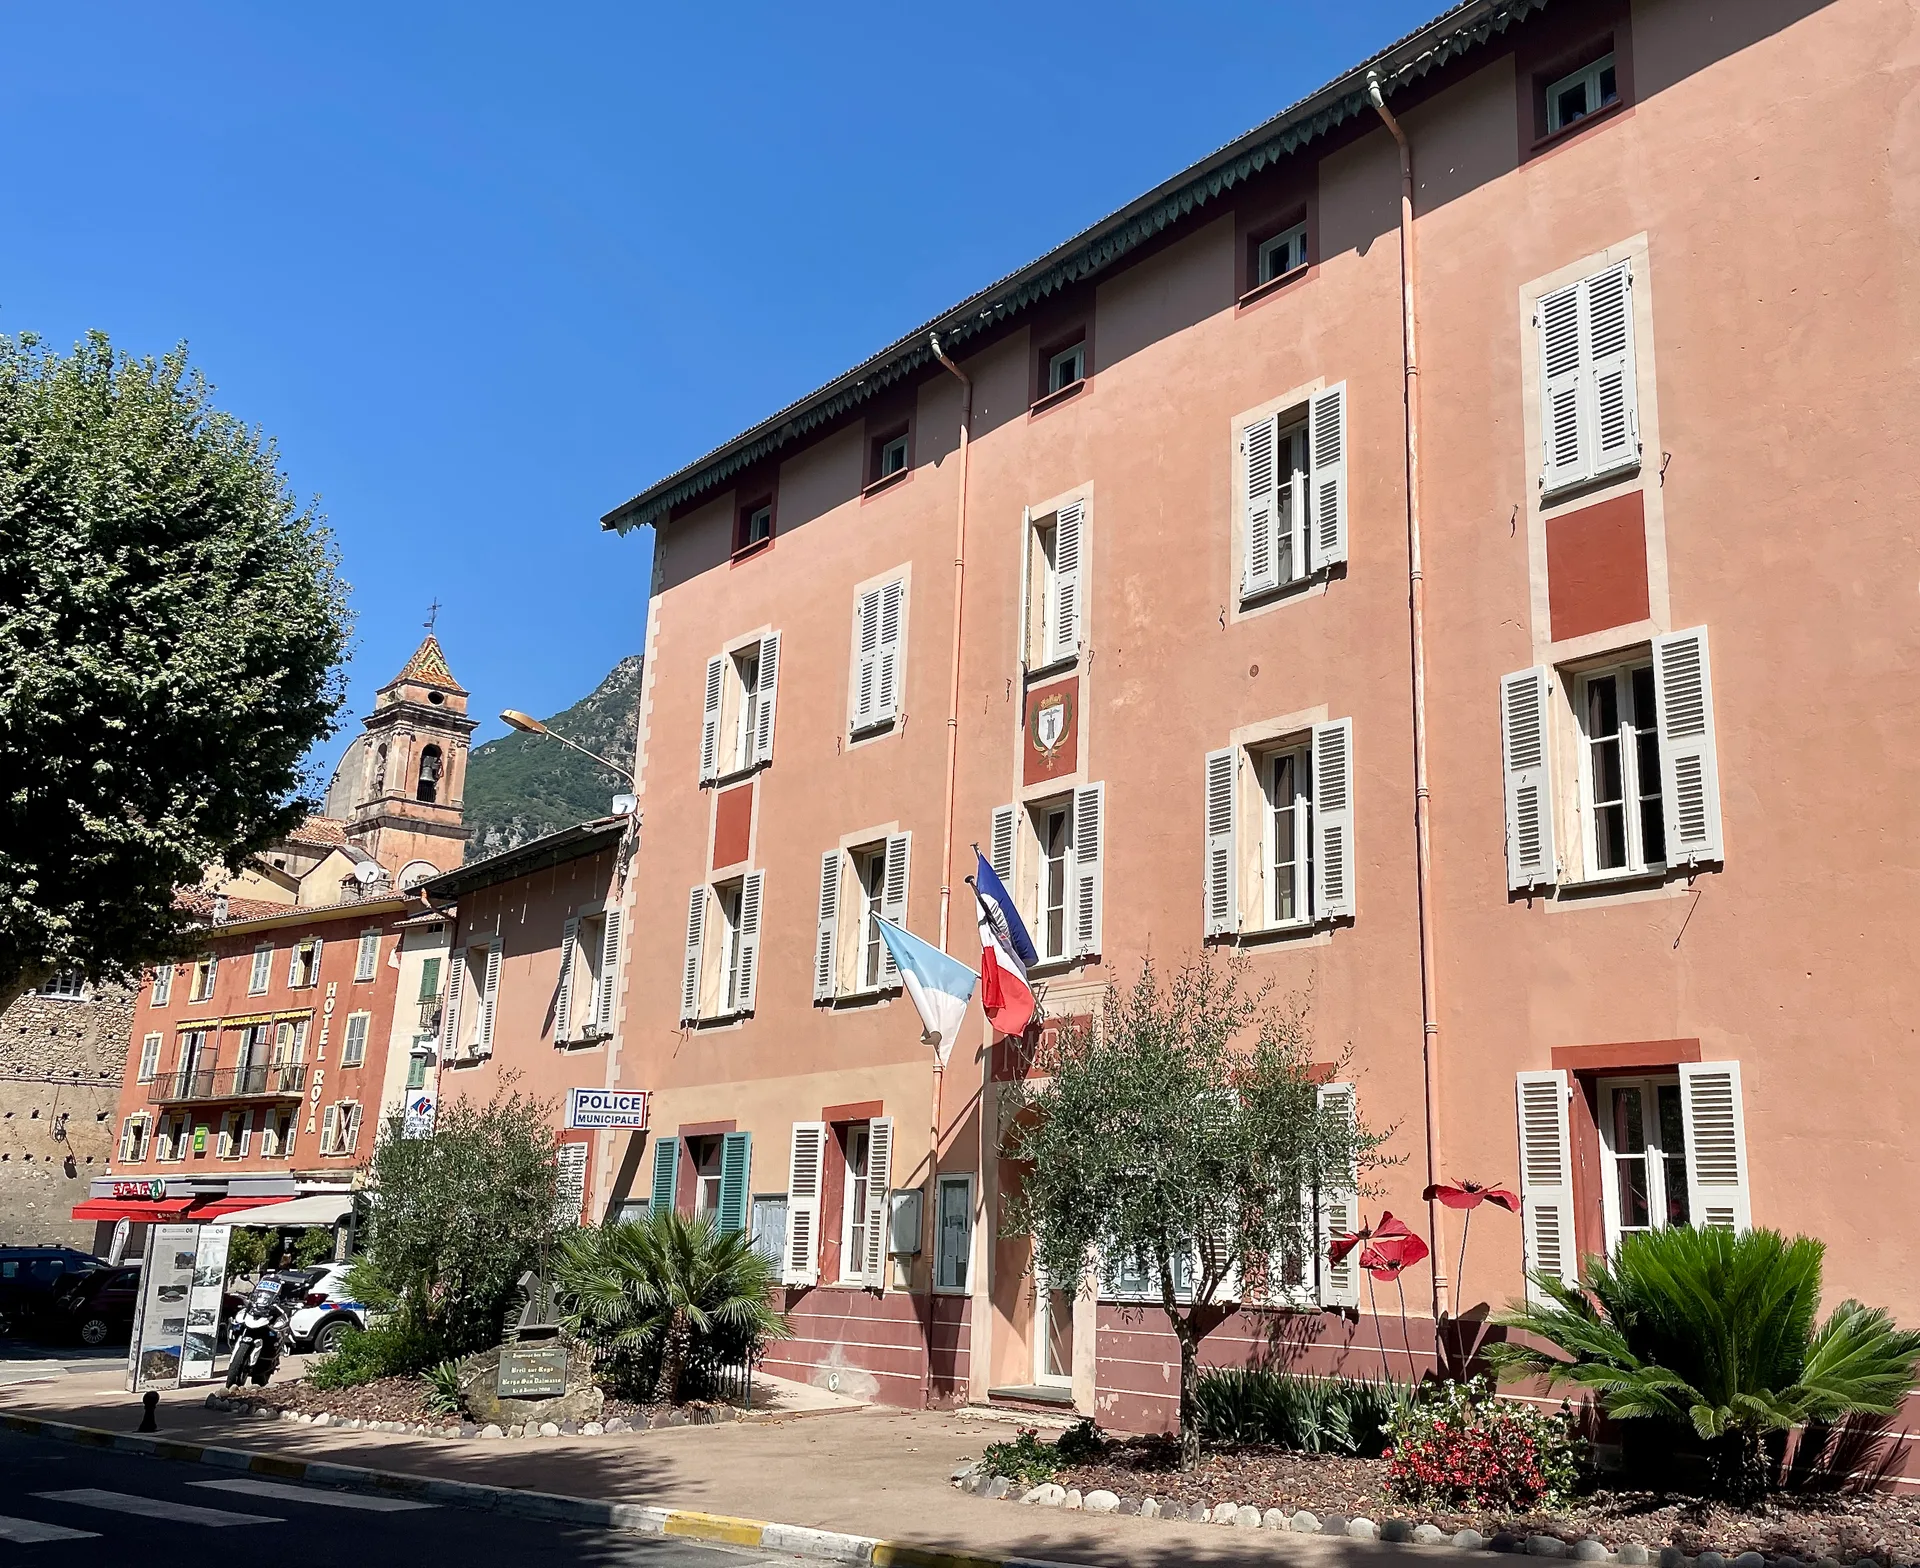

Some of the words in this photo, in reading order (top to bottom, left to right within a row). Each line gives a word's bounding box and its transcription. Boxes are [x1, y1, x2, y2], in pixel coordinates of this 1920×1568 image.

[316, 981, 338, 1062] HOTEL
[305, 1069, 325, 1134] ROYA
[579, 1095, 641, 1110] POLICE
[577, 1114, 640, 1124] MUNICIPALE
[112, 1182, 151, 1196] SPAR
